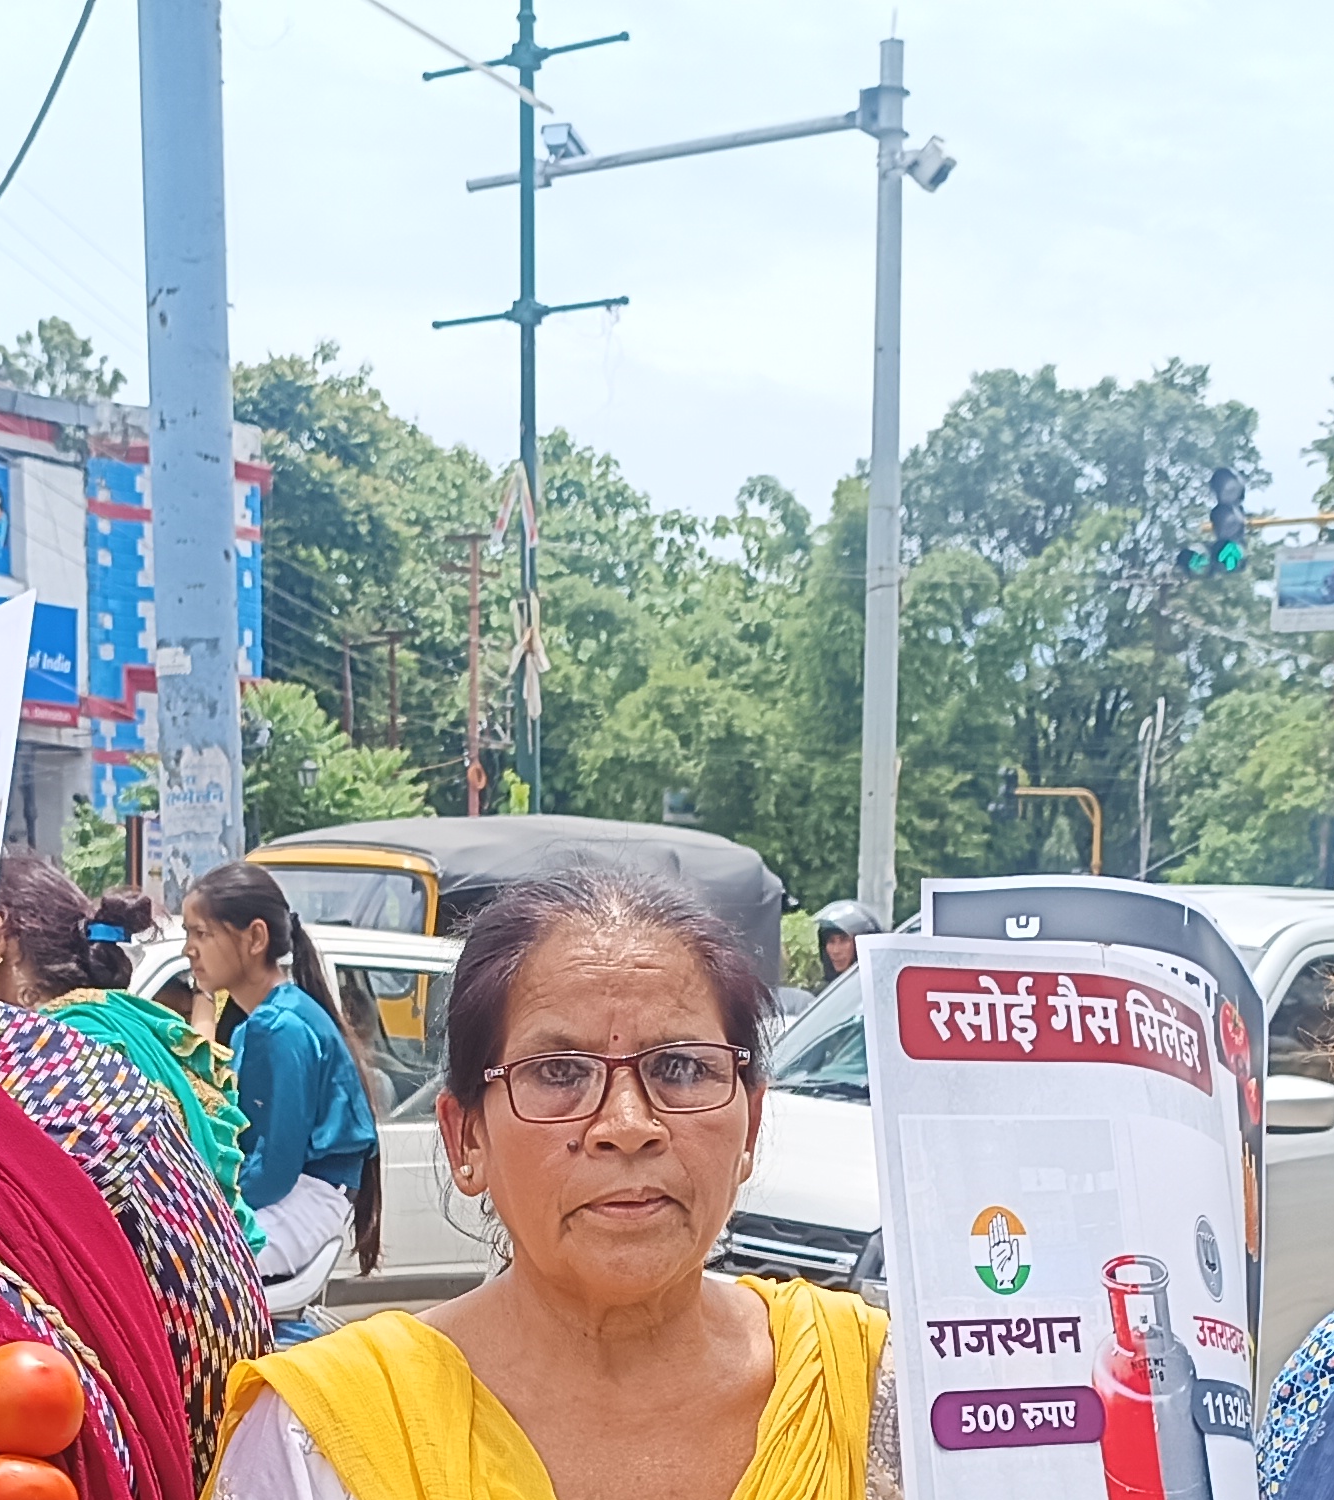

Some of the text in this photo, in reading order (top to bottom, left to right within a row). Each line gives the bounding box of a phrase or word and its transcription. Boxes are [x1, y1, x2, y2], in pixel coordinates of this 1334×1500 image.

[42, 653, 72, 673] India
[926, 975, 1202, 1073] रसोई गैस सिलेंडर
[927, 1316, 1081, 1359] राजस्थान
[961, 1400, 1076, 1433] 500 रुपए
